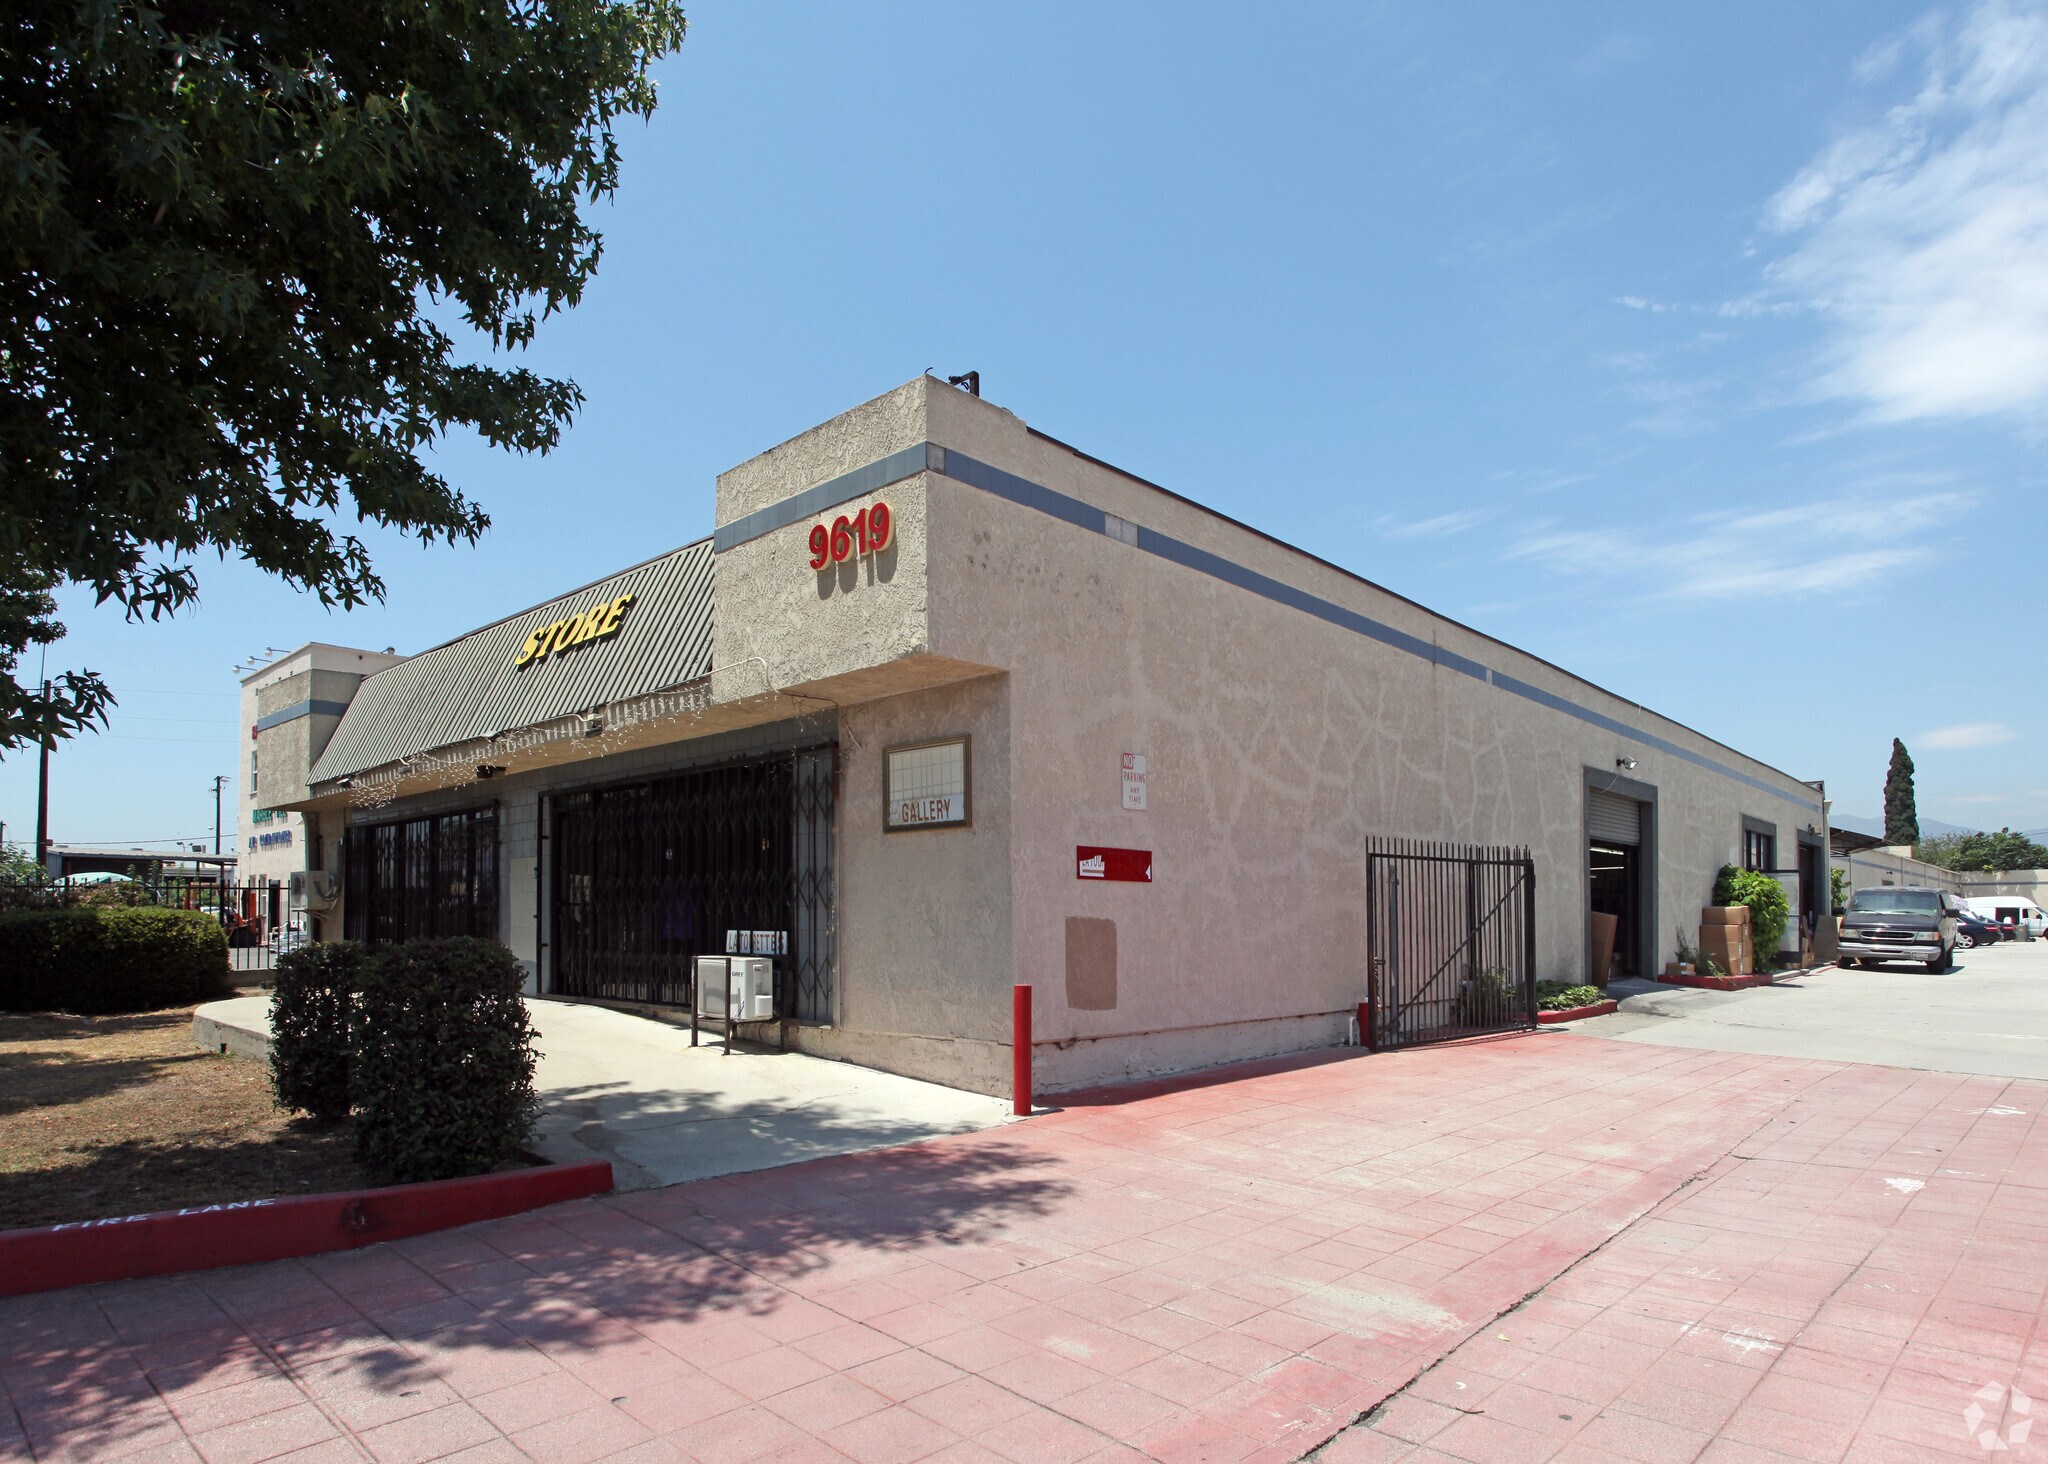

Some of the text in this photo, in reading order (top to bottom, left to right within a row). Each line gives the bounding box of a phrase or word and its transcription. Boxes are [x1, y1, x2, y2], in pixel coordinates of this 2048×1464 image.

[808, 502, 893, 571] 9619
[515, 594, 635, 665] STORE
[1123, 754, 1133, 767] NO
[1123, 771, 1146, 783] PARKING
[902, 799, 950, 822] GALLERY
[52, 1199, 275, 1231] FIRE LANE
